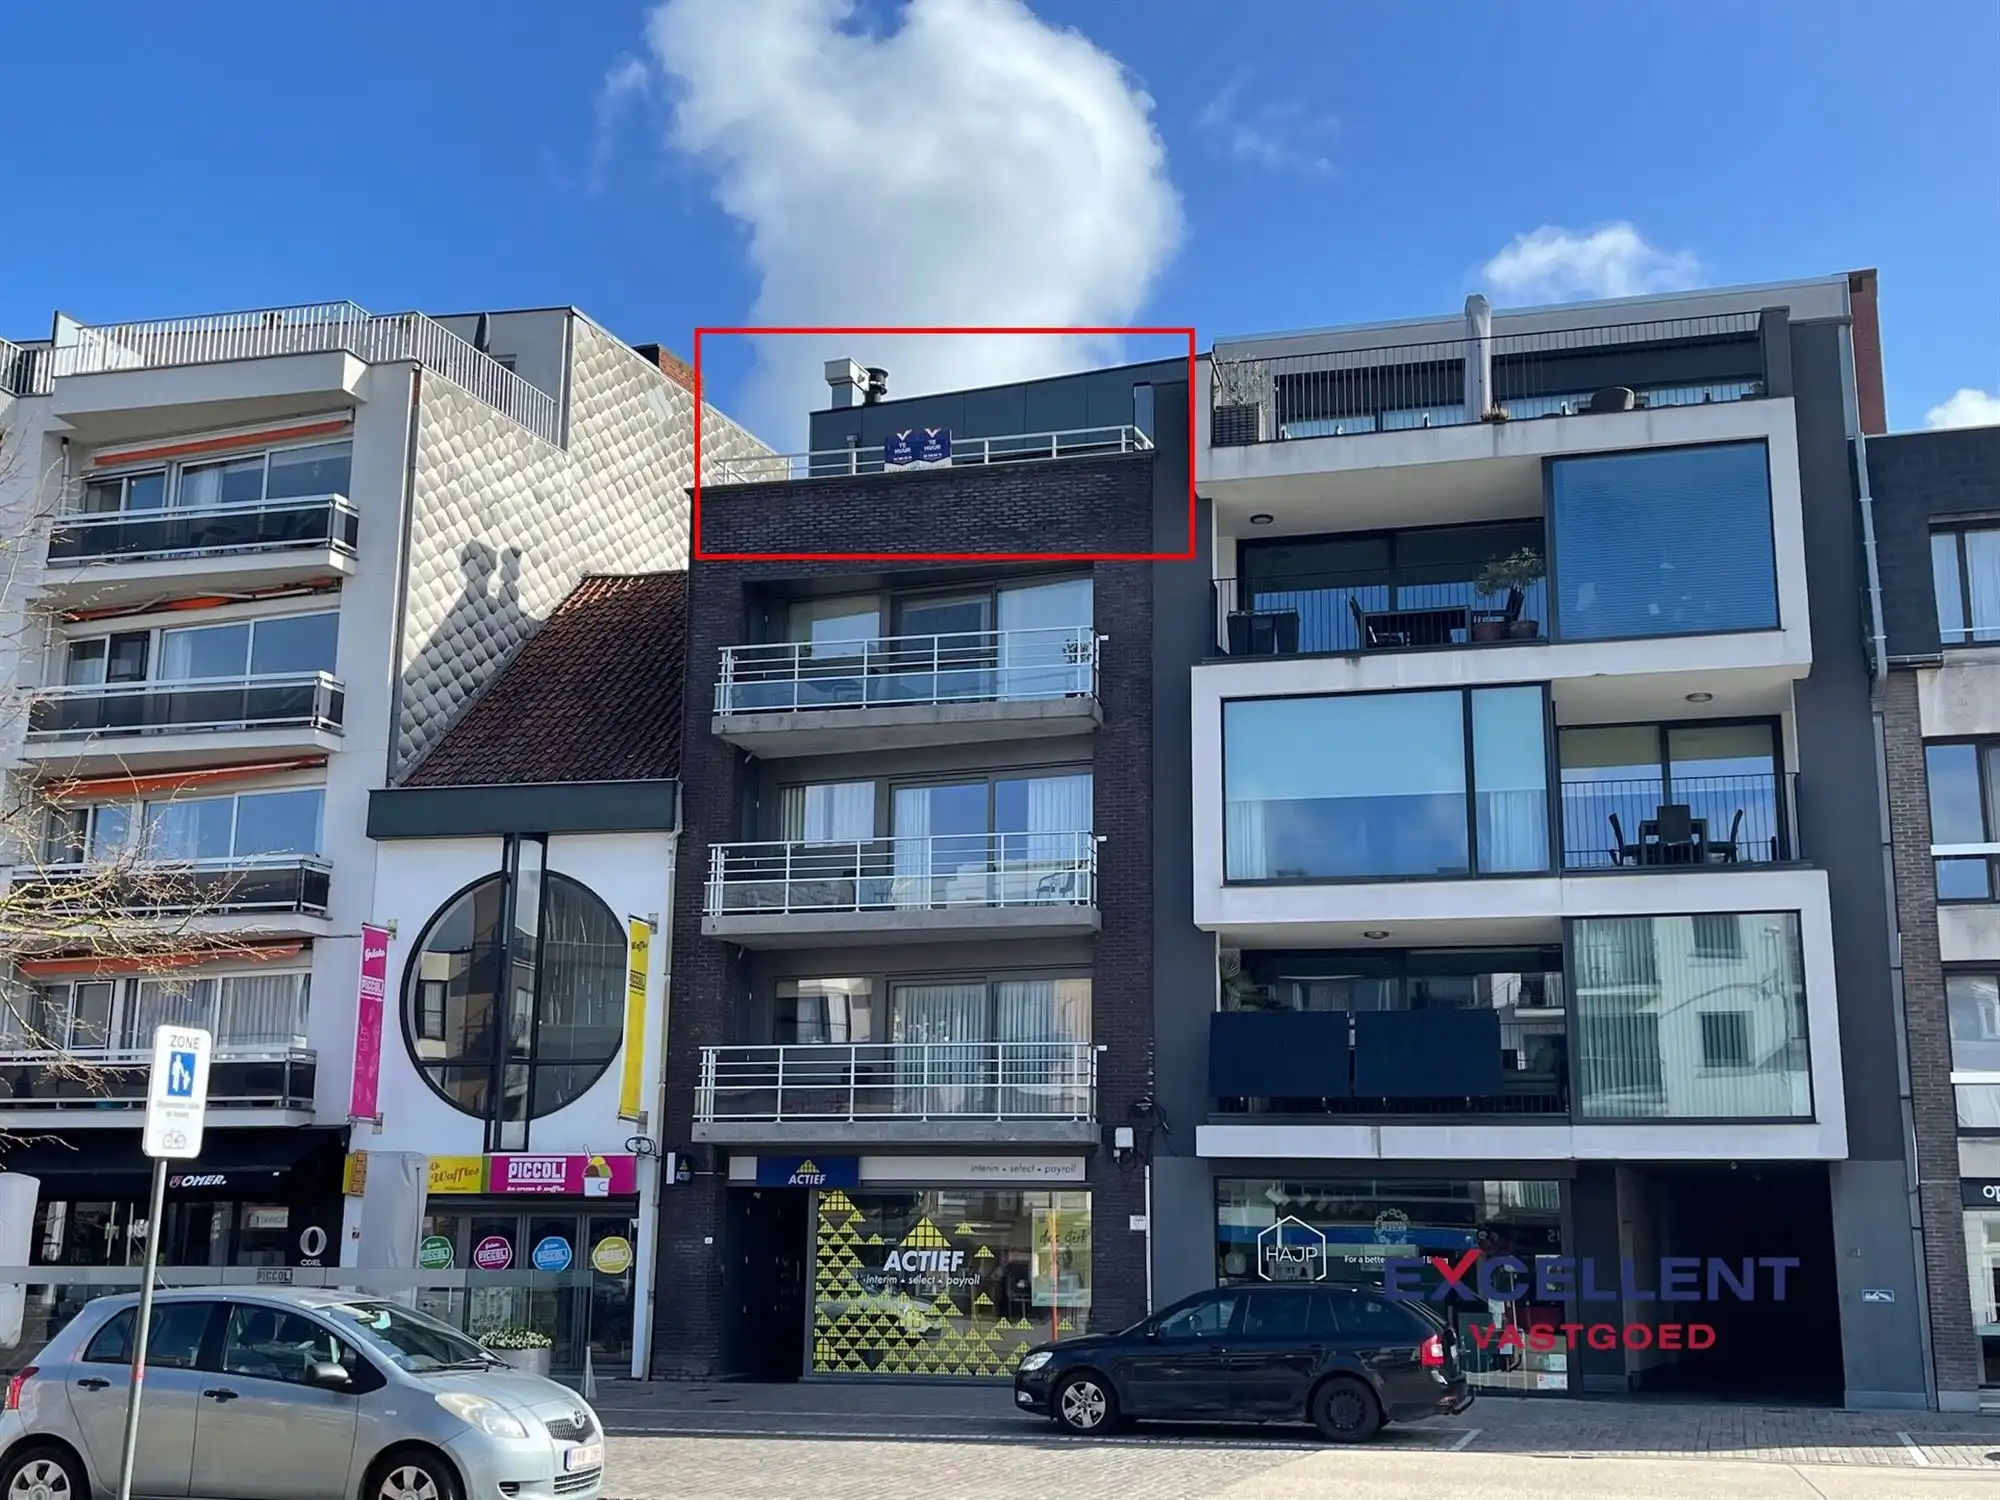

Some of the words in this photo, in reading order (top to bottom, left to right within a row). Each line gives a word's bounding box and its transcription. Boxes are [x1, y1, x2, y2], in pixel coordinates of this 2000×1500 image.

[170, 1034, 201, 1049] ZONE
[508, 1162, 567, 1178] PICCOLI
[970, 1164, 1000, 1173] interim
[1009, 1163, 1035, 1173] select
[1044, 1163, 1076, 1175] payroll
[788, 1174, 827, 1185] ACTIEF
[882, 1250, 965, 1272] ACTIEF
[1266, 1247, 1319, 1263] HAJP
[1344, 1255, 1357, 1263] For
[1364, 1255, 1386, 1263] bette
[257, 1270, 293, 1282] PICCOLI
[866, 1275, 898, 1284] interim
[908, 1274, 936, 1285] select
[946, 1274, 981, 1287] payroll
